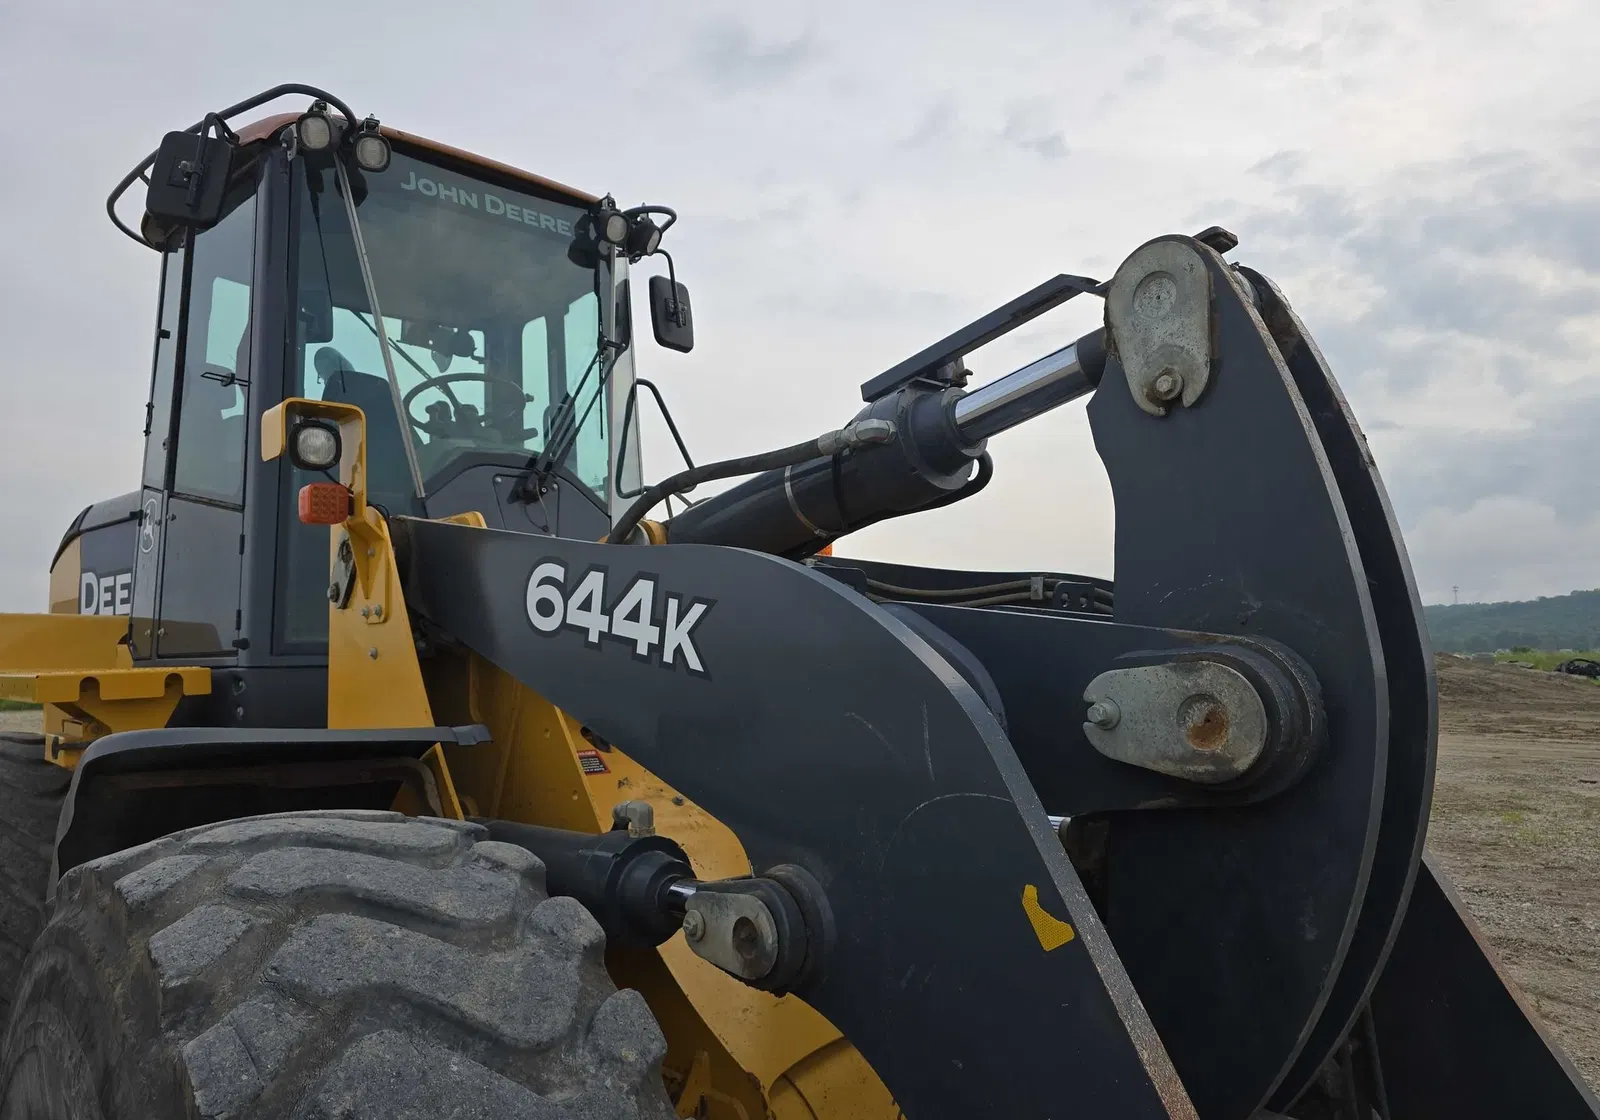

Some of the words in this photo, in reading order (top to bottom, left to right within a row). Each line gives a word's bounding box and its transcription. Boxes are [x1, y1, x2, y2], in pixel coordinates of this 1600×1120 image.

[401, 171, 479, 209] JOHN
[484, 193, 572, 237] DEERE
[526, 562, 708, 673] 644K
